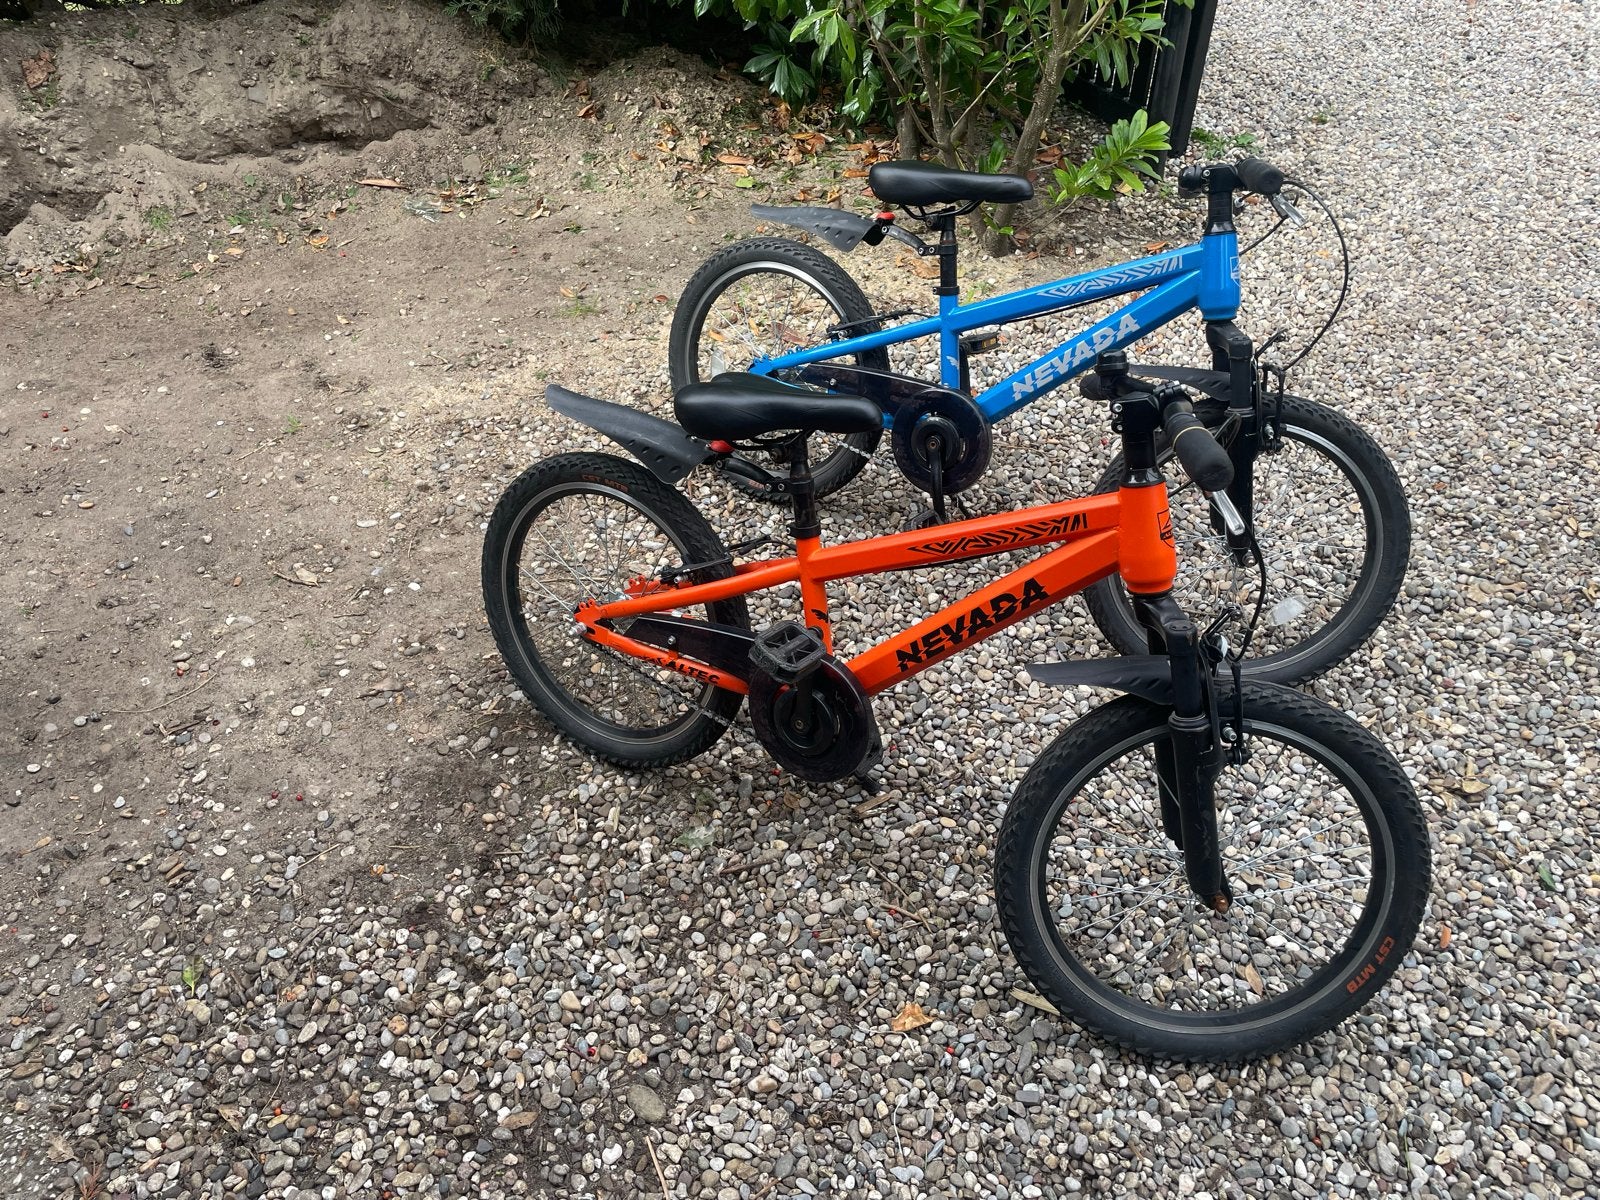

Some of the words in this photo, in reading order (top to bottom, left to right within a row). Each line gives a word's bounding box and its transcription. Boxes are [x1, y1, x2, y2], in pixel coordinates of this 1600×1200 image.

[1012, 313, 1141, 401] NEVADA
[895, 577, 1050, 673] NEVADA
[665, 659, 721, 685] ALTEC
[1375, 936, 1395, 965] CST
[1346, 963, 1376, 994] MTB
